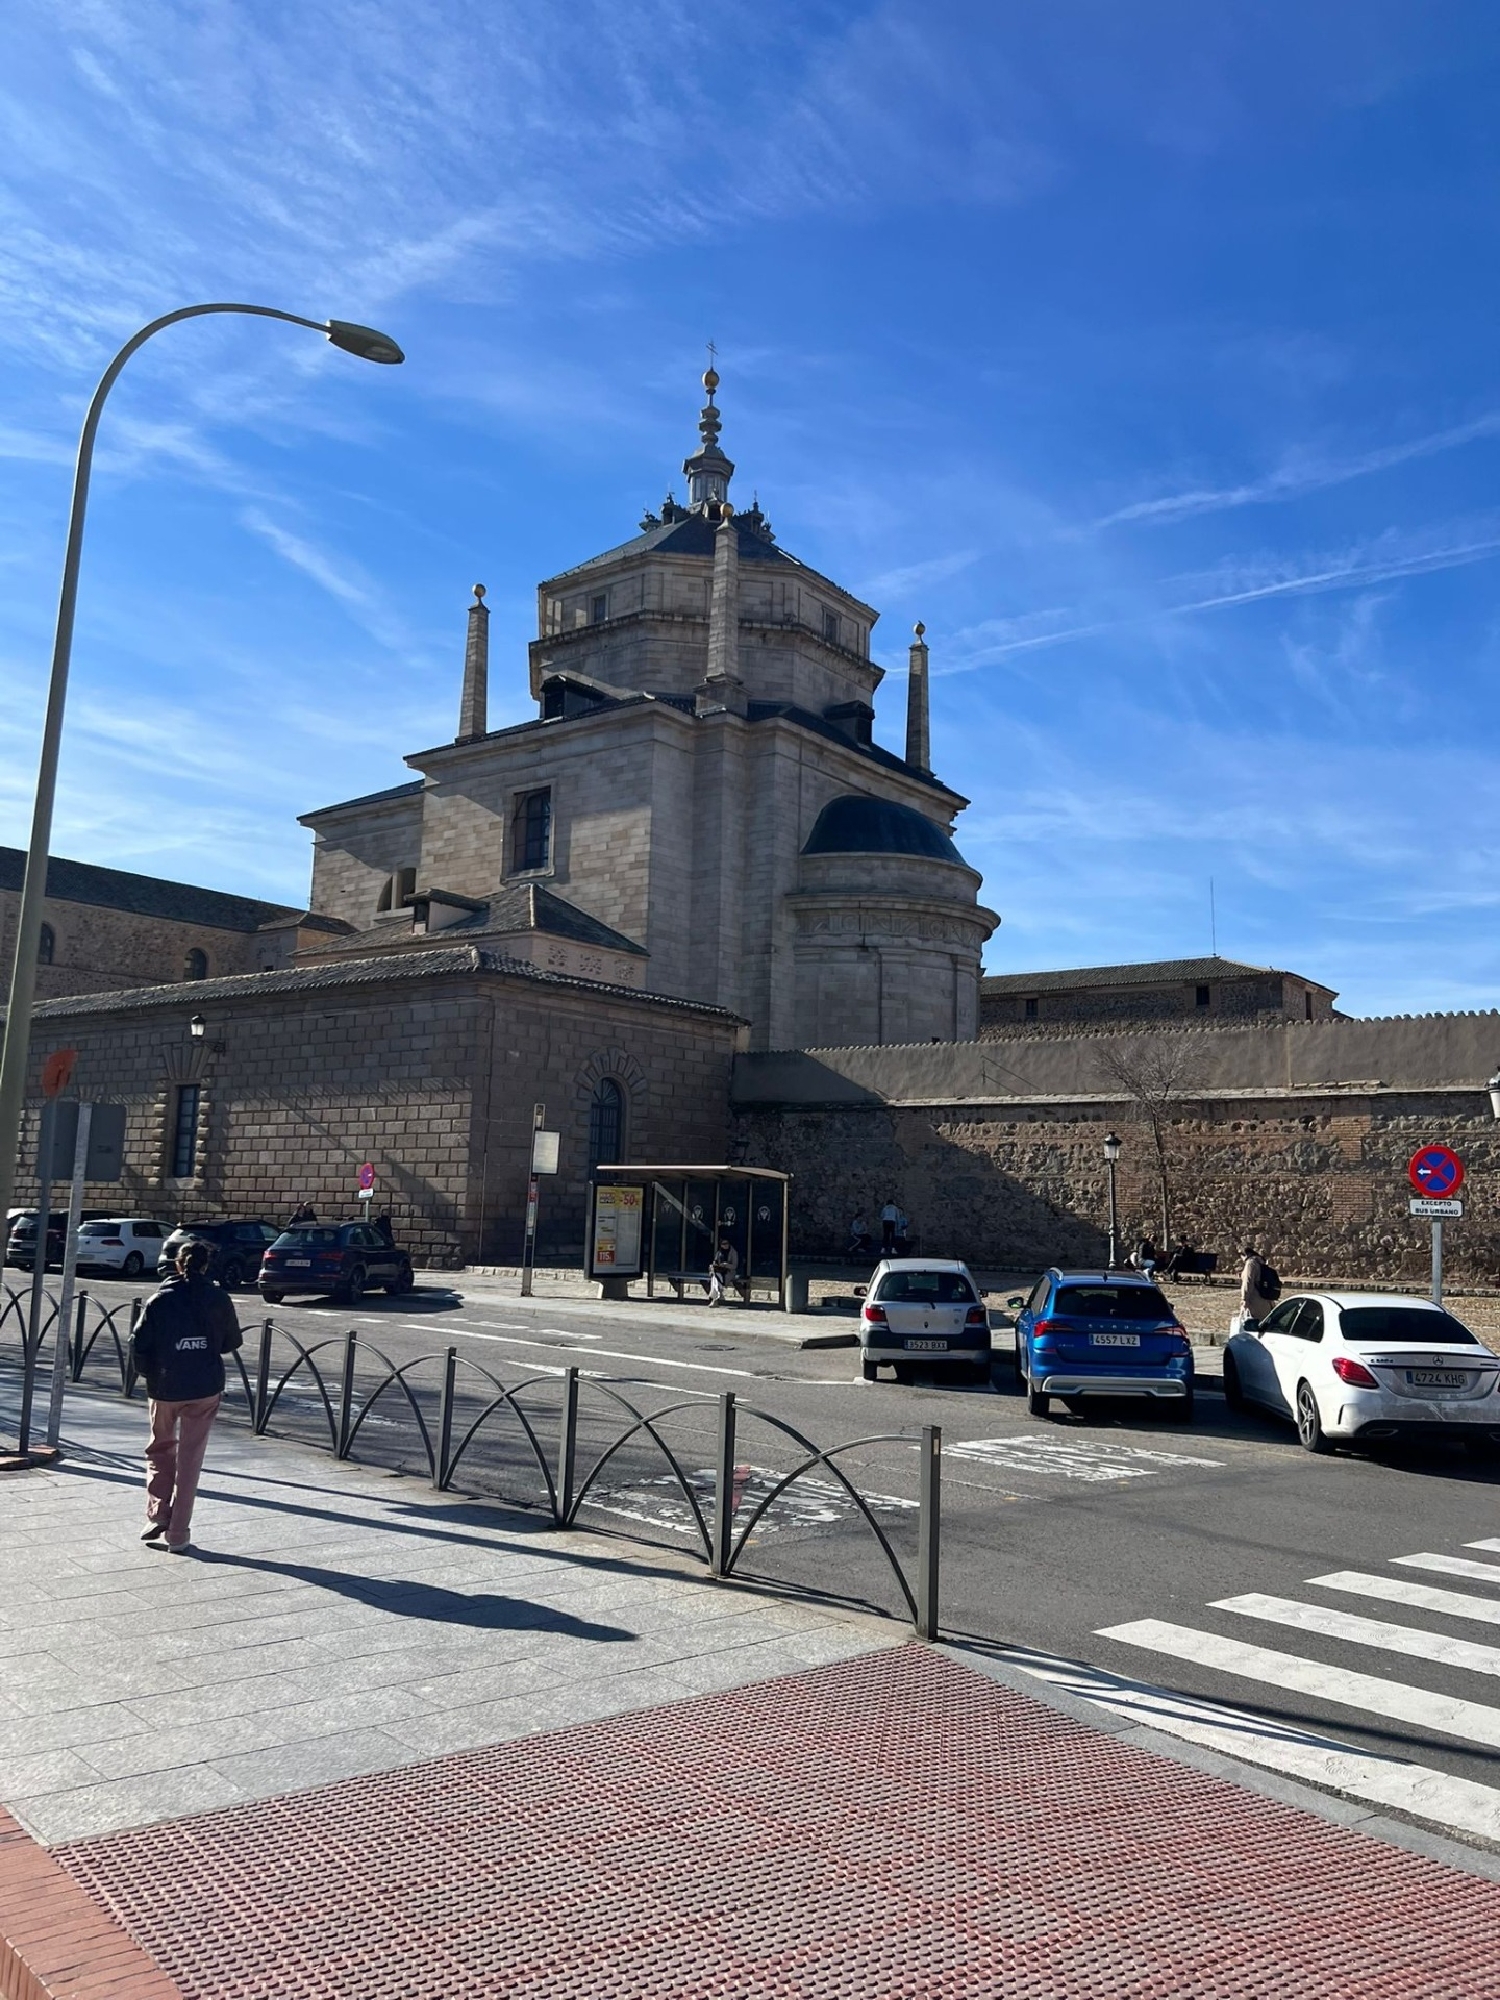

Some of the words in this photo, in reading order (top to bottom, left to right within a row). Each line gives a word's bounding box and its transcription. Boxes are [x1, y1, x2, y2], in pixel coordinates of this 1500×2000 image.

[176, 1335, 207, 1350] VANS
[1095, 1334, 1117, 1344] 4557
[1120, 1335, 1137, 1345] LXZ
[1415, 1373, 1442, 1383] 4724
[1445, 1374, 1465, 1384] KHG
